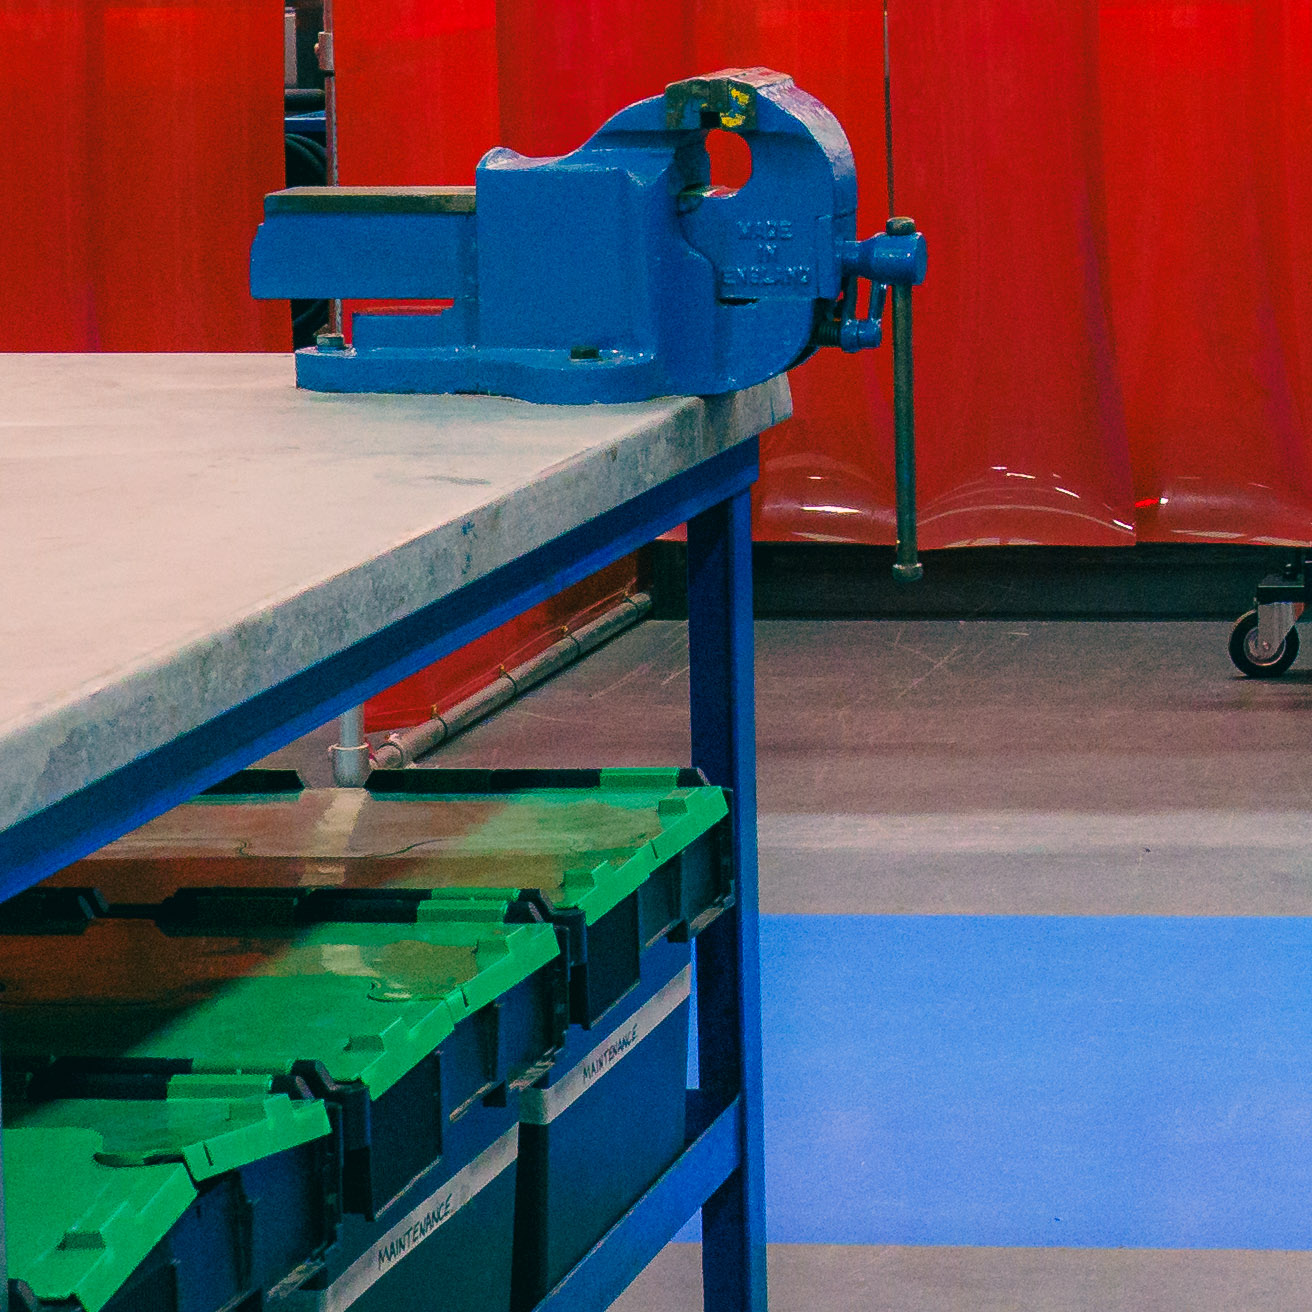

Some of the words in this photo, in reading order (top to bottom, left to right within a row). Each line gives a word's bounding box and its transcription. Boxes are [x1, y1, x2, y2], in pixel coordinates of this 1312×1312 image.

[736, 219, 793, 240] MADE
[723, 265, 810, 285] ENGLAND
[582, 1023, 638, 1084] MAINTENANCE
[377, 1192, 453, 1271] MAINTENANCE
